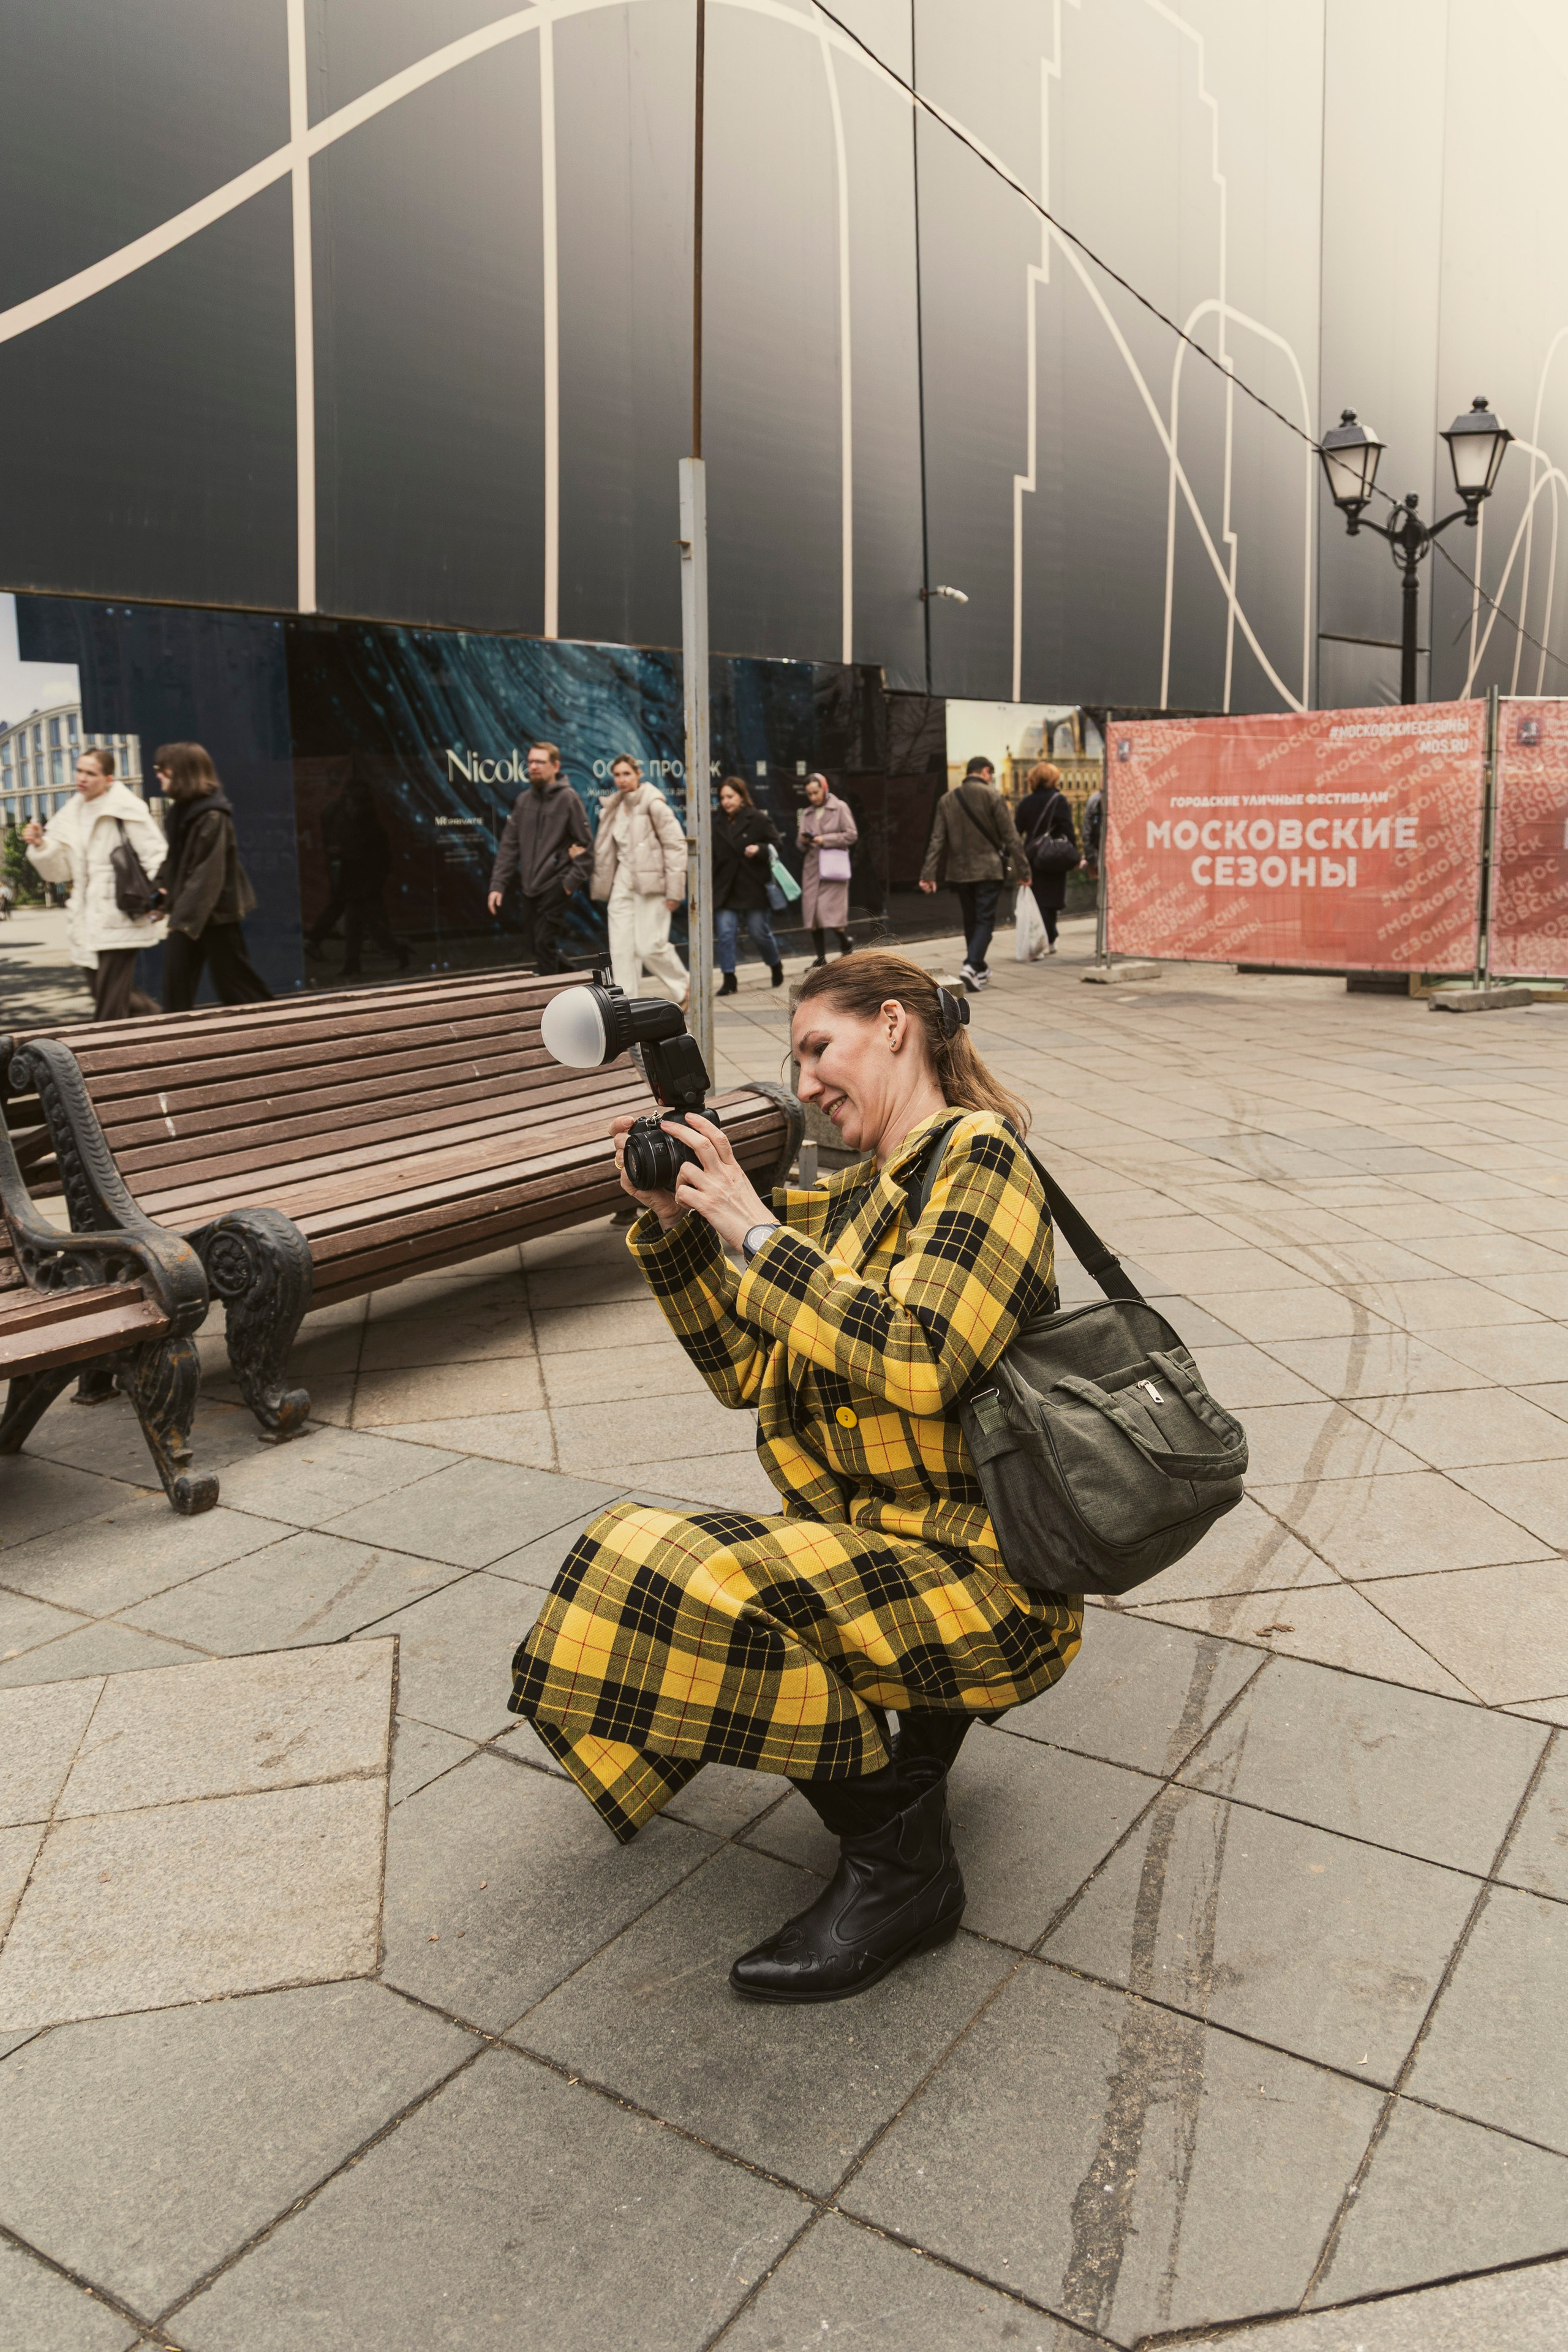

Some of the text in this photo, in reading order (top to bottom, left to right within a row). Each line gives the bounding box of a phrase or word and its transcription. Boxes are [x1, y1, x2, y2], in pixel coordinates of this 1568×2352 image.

[1170, 791, 1389, 808] ГОРОДСКИЕ УЛИЧНЫЕ ФЕСТИВАЛИ
[1146, 817, 1419, 850] МОСКОВСКИЕ
[1191, 855, 1357, 888] СЕЗОНЫ
